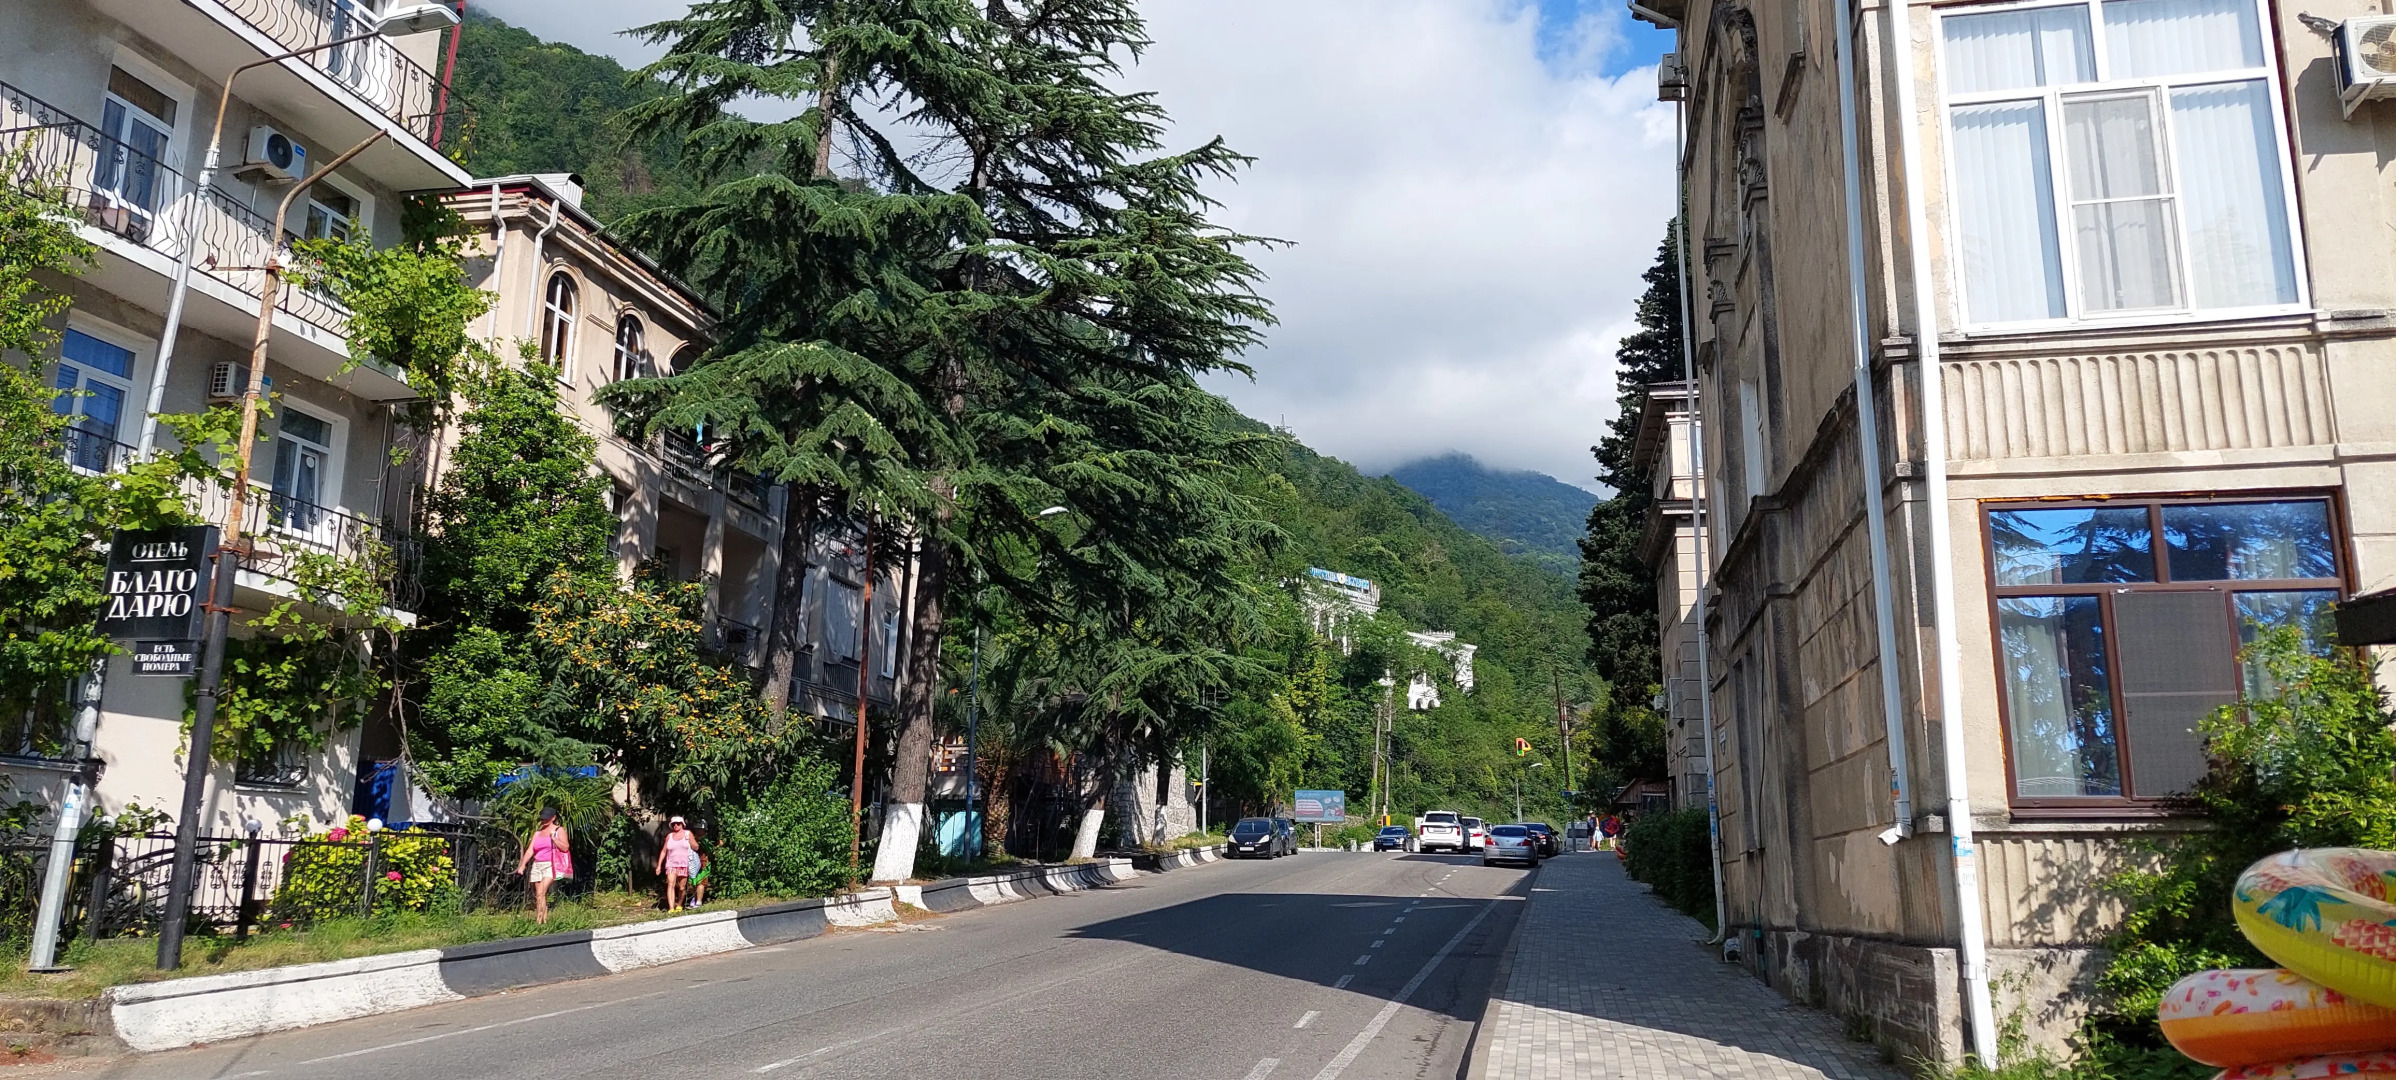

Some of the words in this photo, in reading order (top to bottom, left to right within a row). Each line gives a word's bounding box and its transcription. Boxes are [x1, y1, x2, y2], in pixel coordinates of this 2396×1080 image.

[132, 542, 188, 559] ОТЕЛЬ
[109, 569, 197, 594] БЛАГО
[105, 594, 192, 621] ДАРЮ
[154, 644, 175, 653] ЕСТЬ
[134, 653, 192, 662] СВОБОДНЫЕ
[142, 662, 180, 671] НОМЕРА
